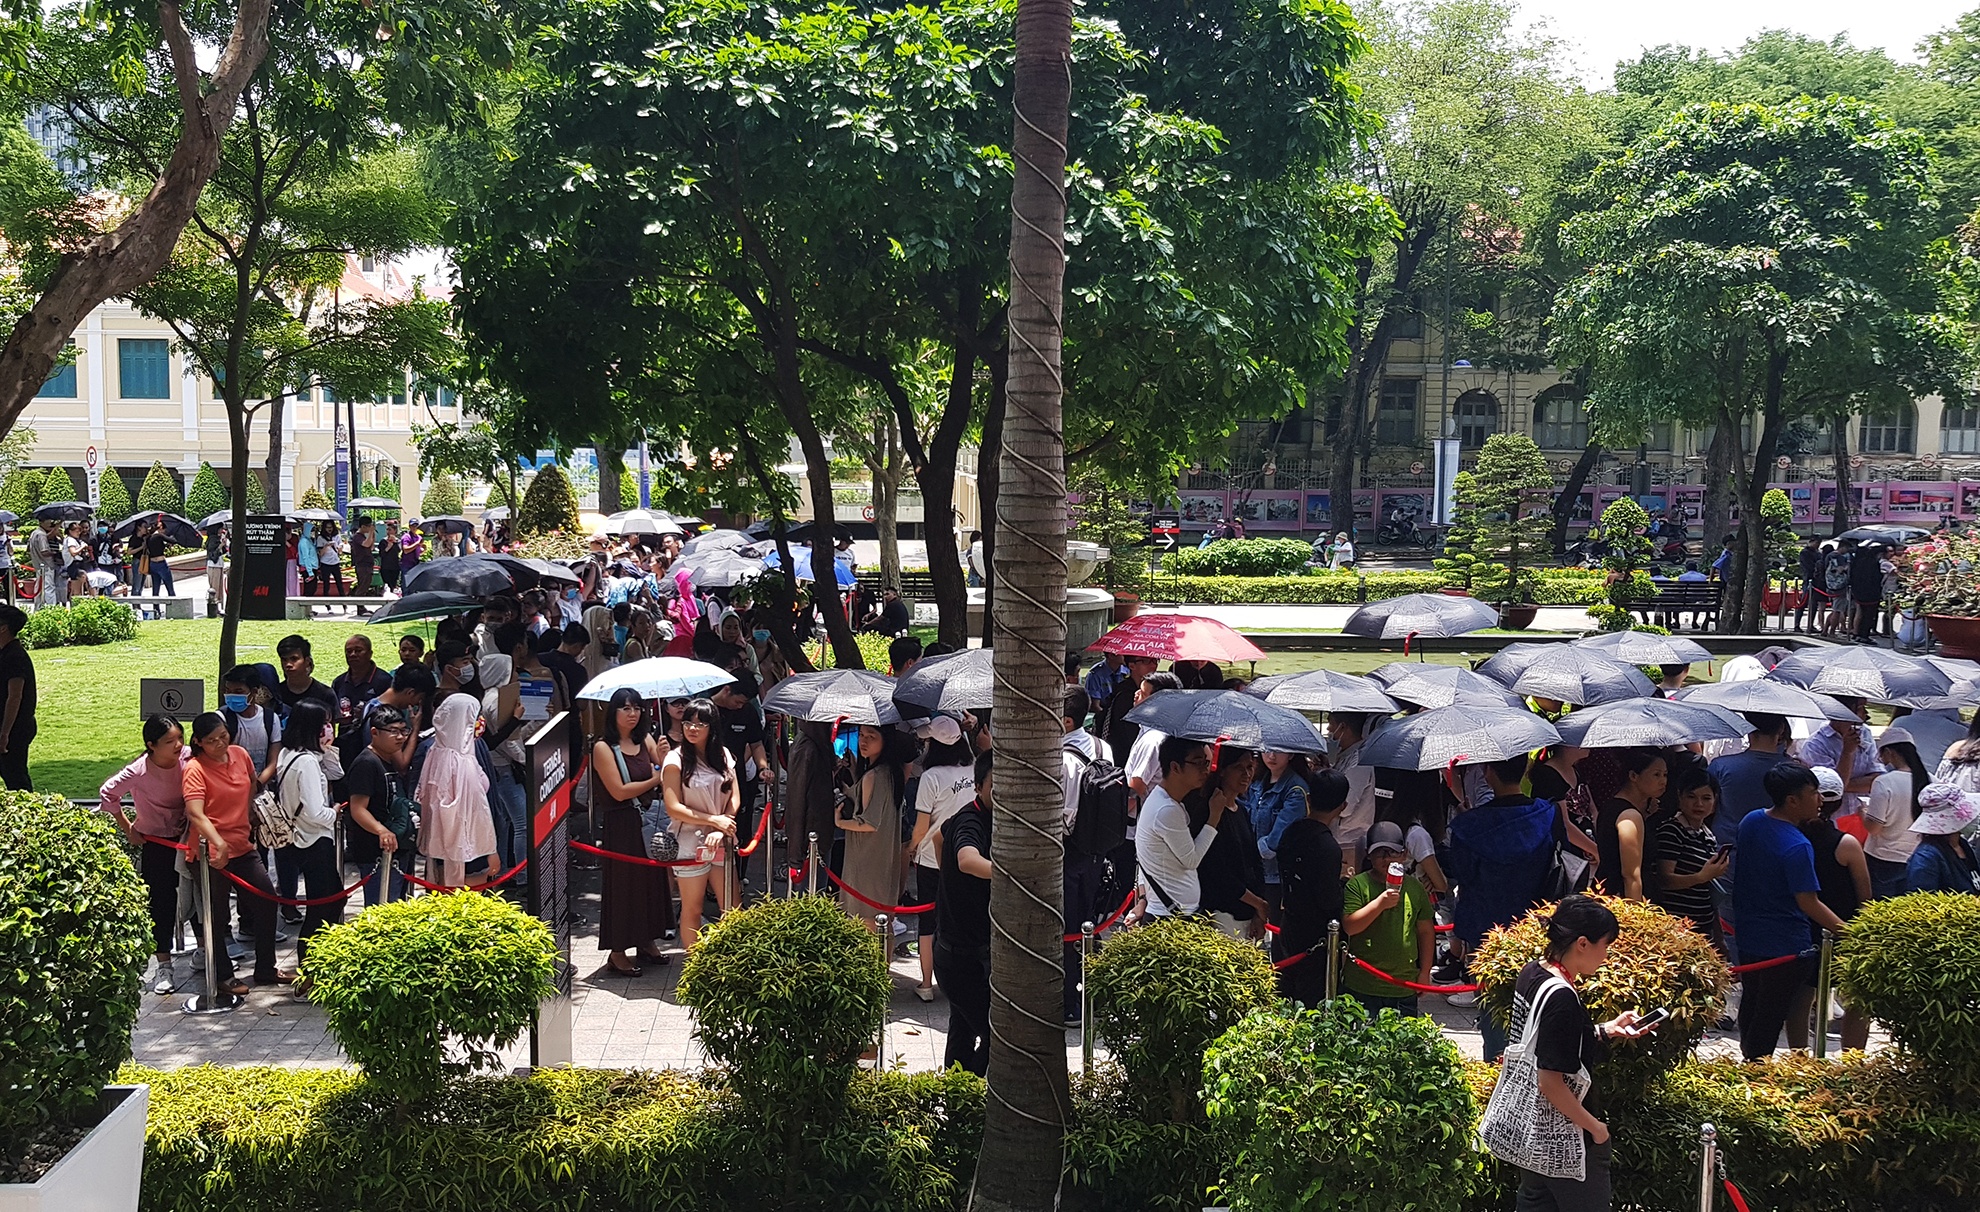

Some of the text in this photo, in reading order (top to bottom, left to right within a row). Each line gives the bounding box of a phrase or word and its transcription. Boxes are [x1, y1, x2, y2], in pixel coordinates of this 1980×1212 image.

[1123, 642, 1146, 651] AIA
[1146, 641, 1165, 649] AIA
[540, 762, 566, 802] CONDITIONS
[1494, 1127, 1512, 1143] YORK
[1495, 1120, 1515, 1137] NEW
[1536, 1132, 1573, 1141] SINGAPORE
[1556, 1141, 1564, 1170] MADRID
